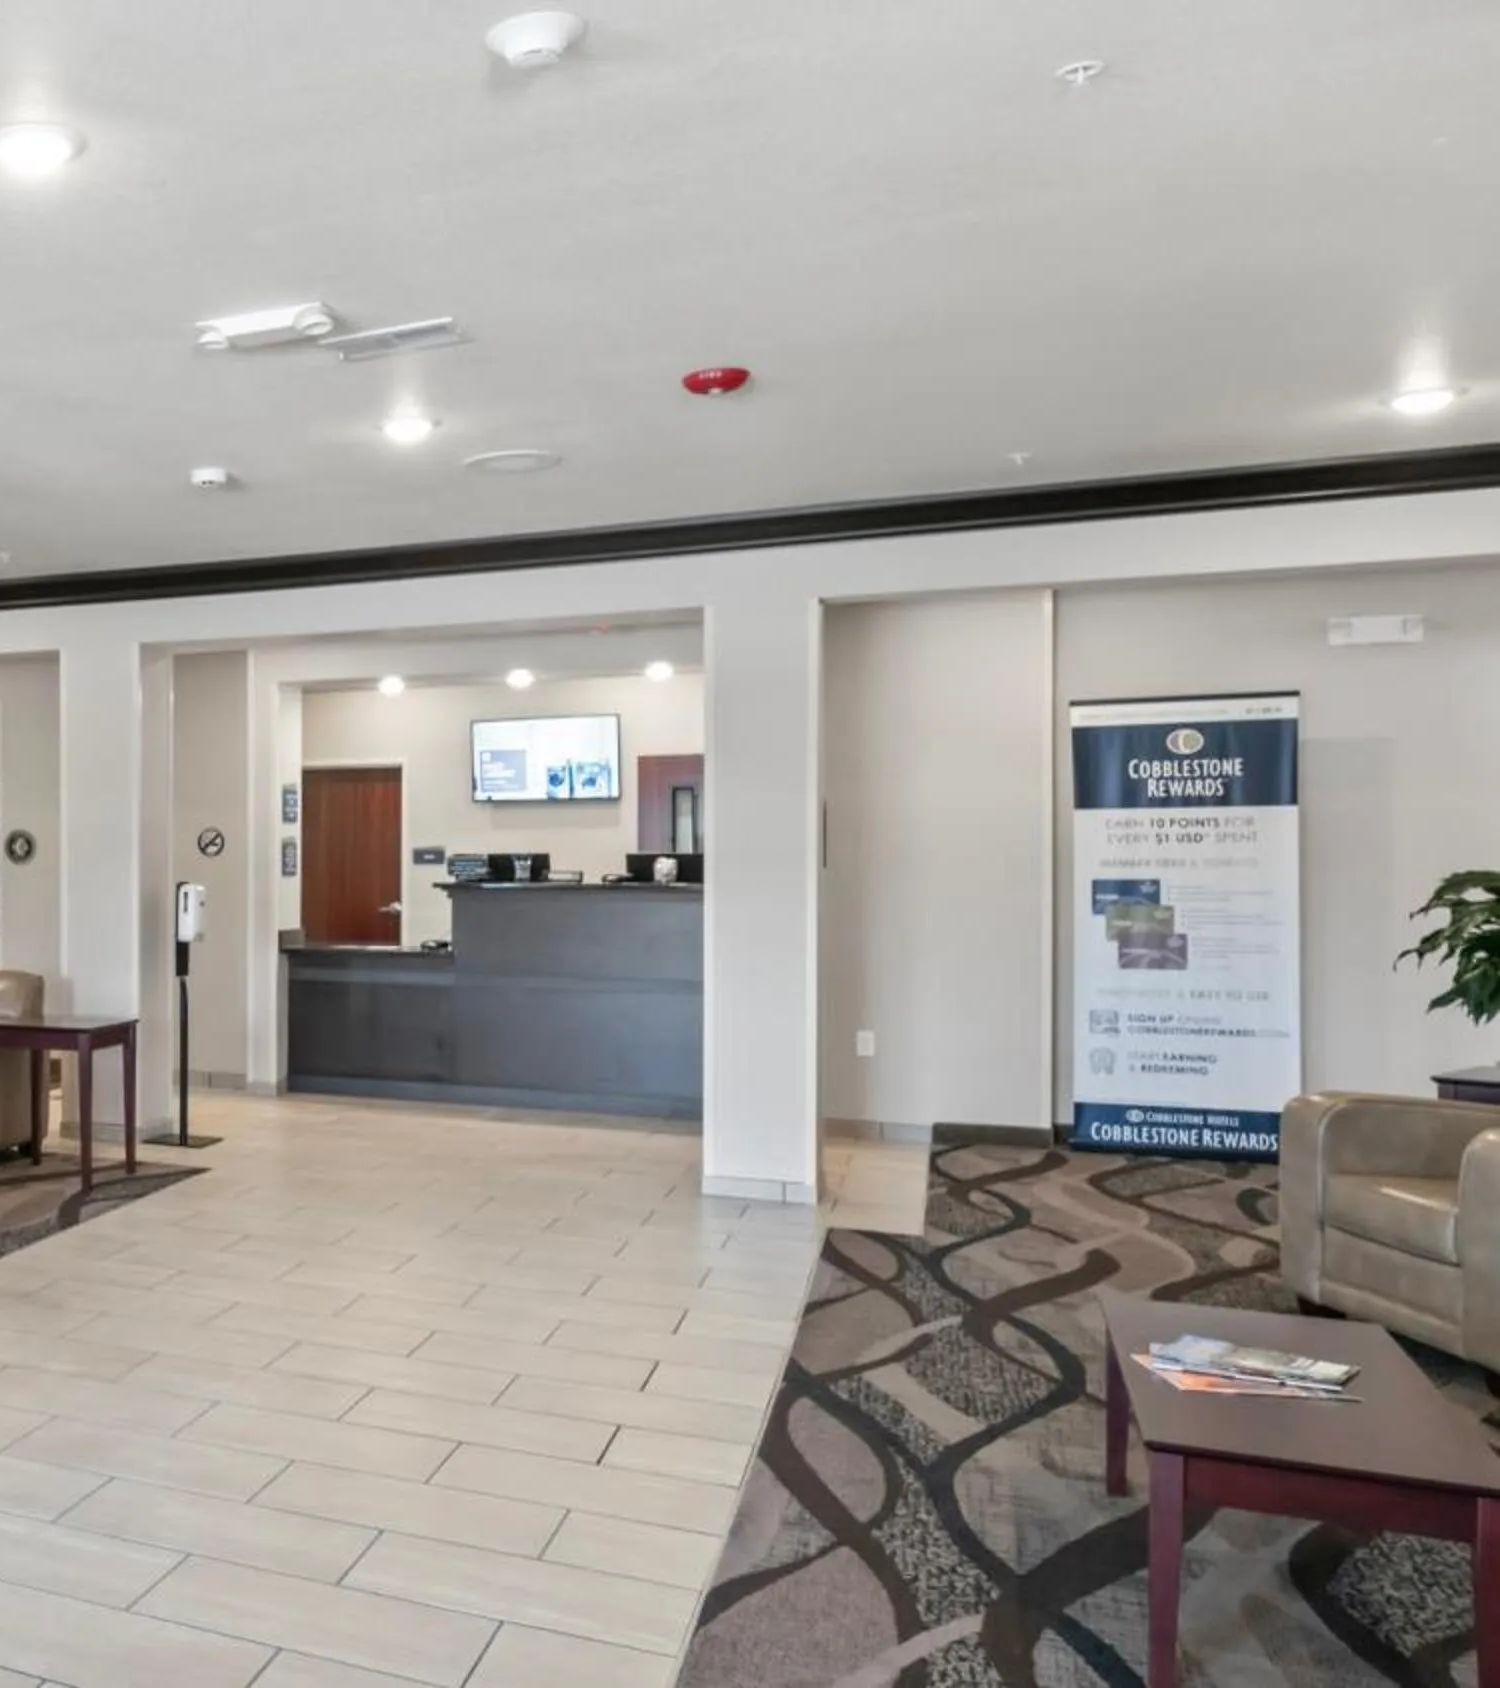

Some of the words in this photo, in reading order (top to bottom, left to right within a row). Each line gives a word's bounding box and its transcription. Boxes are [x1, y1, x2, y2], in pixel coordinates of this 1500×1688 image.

[1128, 757, 1244, 779] COBBLESTONE
[1148, 778, 1225, 798] REWARDS
[1105, 817, 1145, 829] EARN
[1150, 817, 1165, 829] 10
[1169, 816, 1220, 829] POINTS
[1107, 833, 1150, 845] EVERY
[1155, 833, 1170, 846] $1
[1214, 831, 1259, 844] SPENT
[1127, 1012, 1156, 1024] SIGN
[1126, 1025, 1290, 1038] COBBLESTONEREWARDS
[1162, 1051, 1218, 1064] EARNING
[1140, 1063, 1210, 1076] REDEEMING
[1146, 1109, 1205, 1125] COBBLESTONE
[1091, 1121, 1200, 1147] COBBLESTONE
[1202, 1128, 1279, 1151] REWARDS
